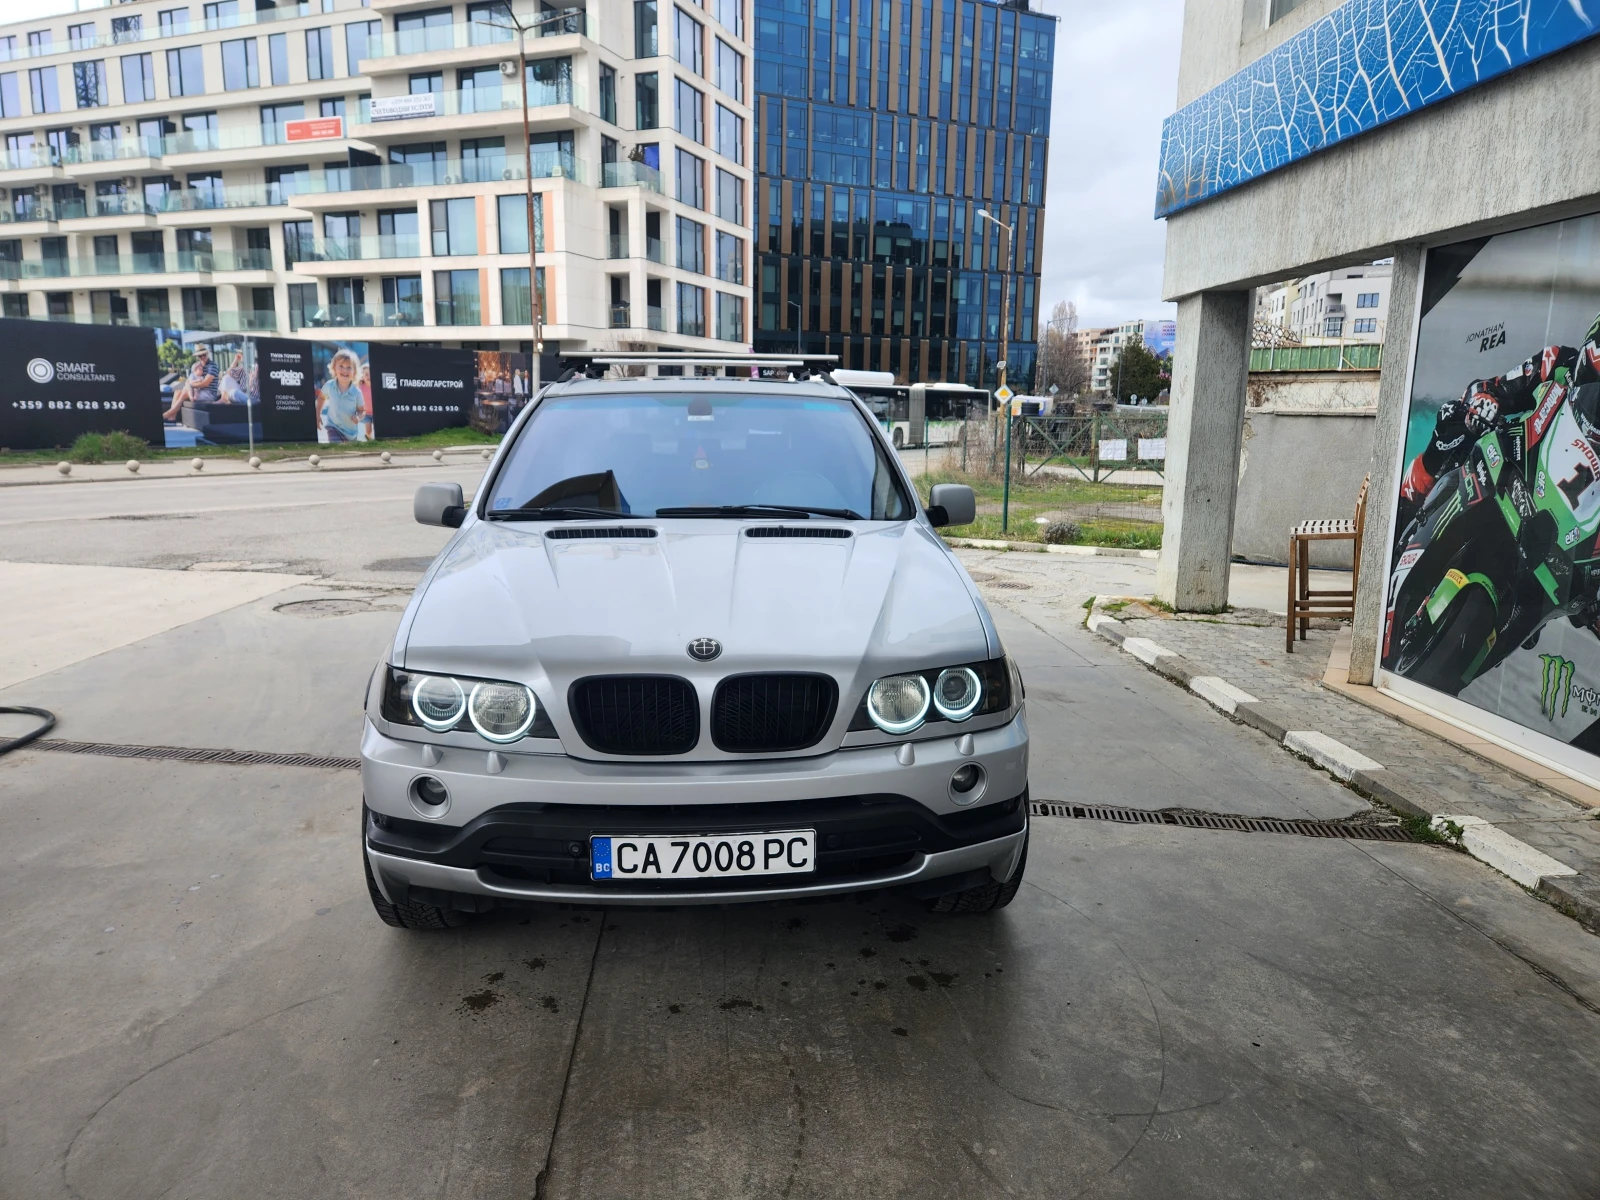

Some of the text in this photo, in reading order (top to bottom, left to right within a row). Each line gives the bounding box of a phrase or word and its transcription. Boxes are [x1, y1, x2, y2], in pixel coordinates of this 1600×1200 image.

[1465, 321, 1505, 344] JONATHAN
[1479, 330, 1506, 353] REA
[55, 361, 96, 374] SMART
[57, 373, 116, 382] CONSULTANTS
[399, 378, 464, 388] ГЛАВБОЛГАРСТРОЙ
[12, 400, 126, 409] +359 882 628 930
[1556, 461, 1594, 511] 1
[617, 837, 808, 874] CA 7008 PC
